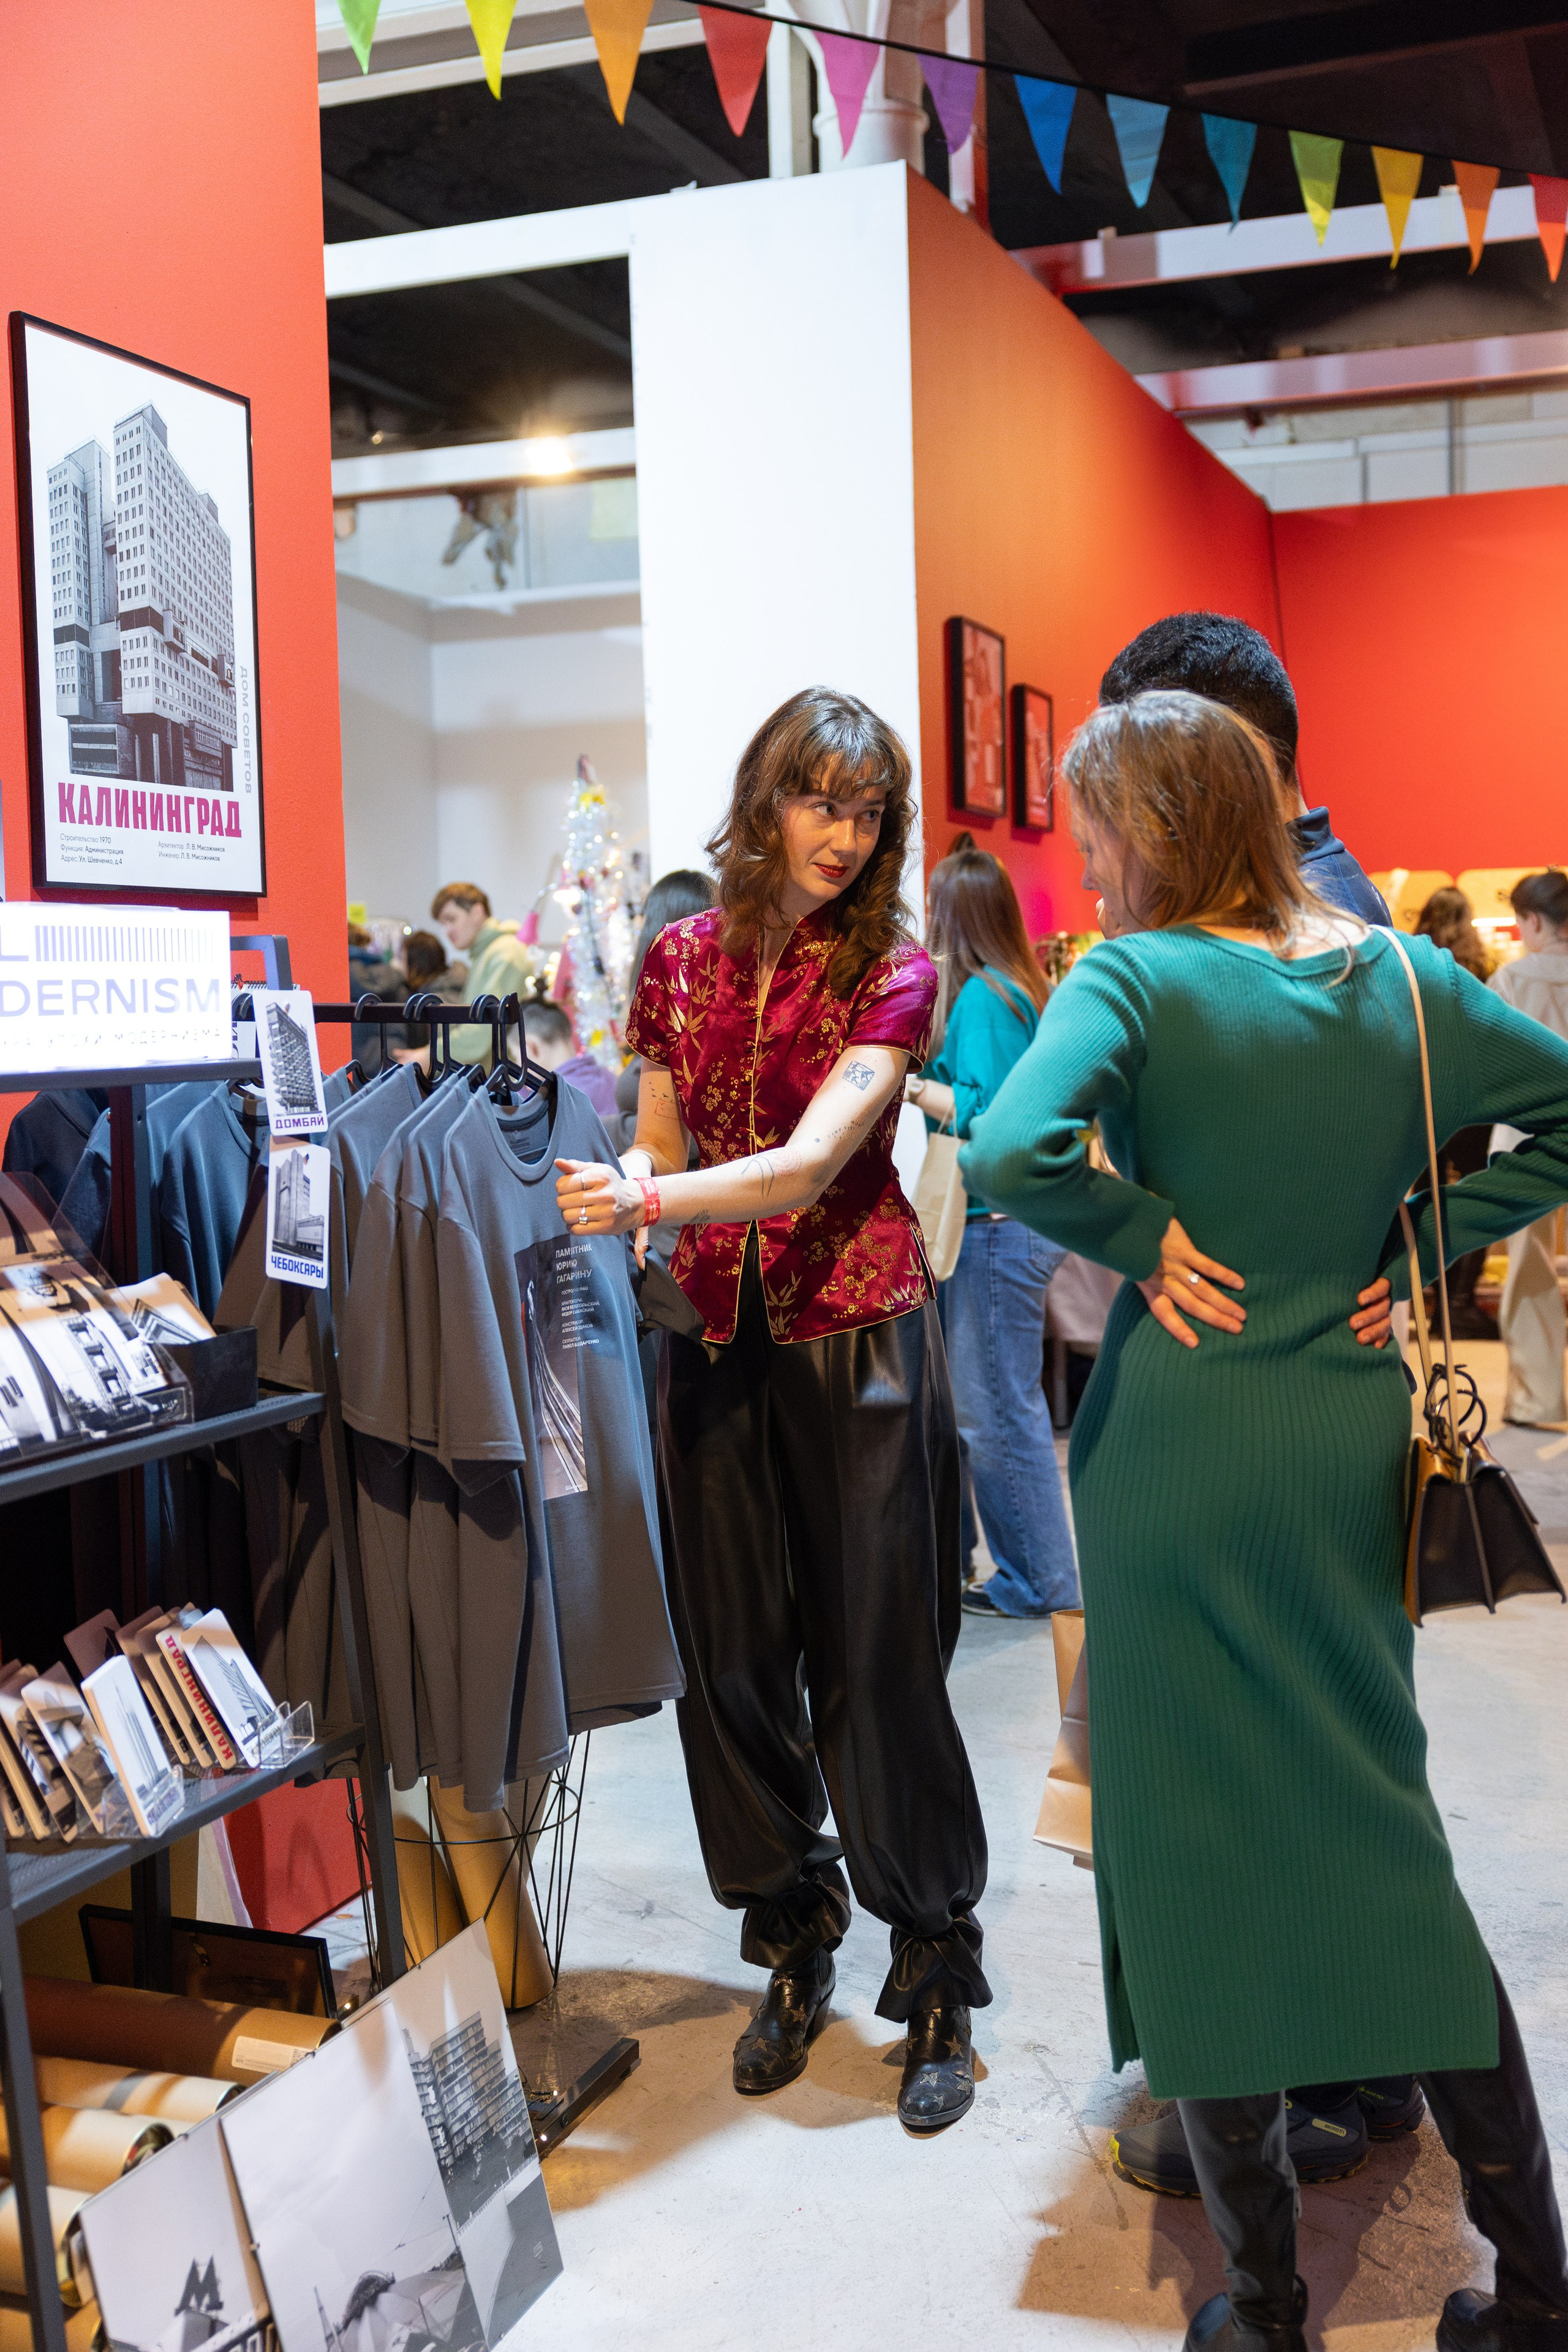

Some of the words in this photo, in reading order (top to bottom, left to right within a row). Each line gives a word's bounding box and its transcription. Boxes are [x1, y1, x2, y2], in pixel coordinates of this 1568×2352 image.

[239, 665, 249, 707] ДОМ
[243, 713, 252, 793] СОВЕТОВ
[58, 782, 242, 838] КАЛИНИНГРАД
[60, 833, 99, 843] Строительство:
[61, 844, 85, 853] Функция:
[85, 845, 124, 855] Администрация
[61, 854, 78, 863] Адрес:
[88, 856, 114, 865] Шевченко,
[275, 1115, 325, 1129] ДОМБАЙ
[556, 1243, 592, 1259] ПАМЯТНИК
[271, 1256, 323, 1279] ЧЕБОКСАРЫ
[556, 1259, 577, 1271] ЮРИЮ
[556, 1268, 592, 1284] ГАГАРИНУ
[164, 1635, 233, 1761] КАЛИНИНГРАД
